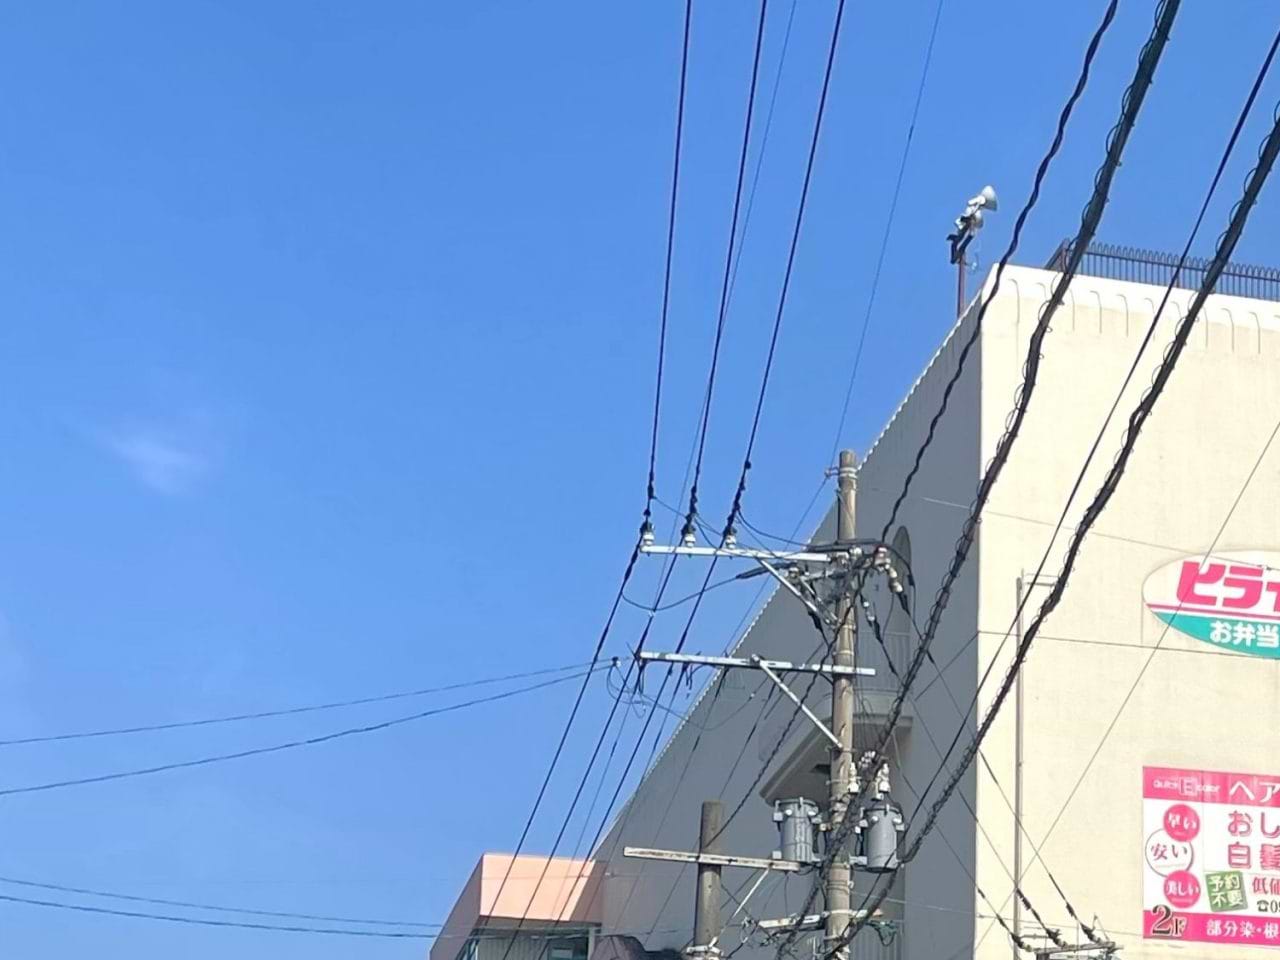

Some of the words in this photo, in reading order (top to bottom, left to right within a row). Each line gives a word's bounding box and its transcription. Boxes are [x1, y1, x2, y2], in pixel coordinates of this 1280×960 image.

[1150, 843, 1188, 862] 安い
[1208, 875, 1241, 893] 予約
[1211, 889, 1244, 909] 不要
